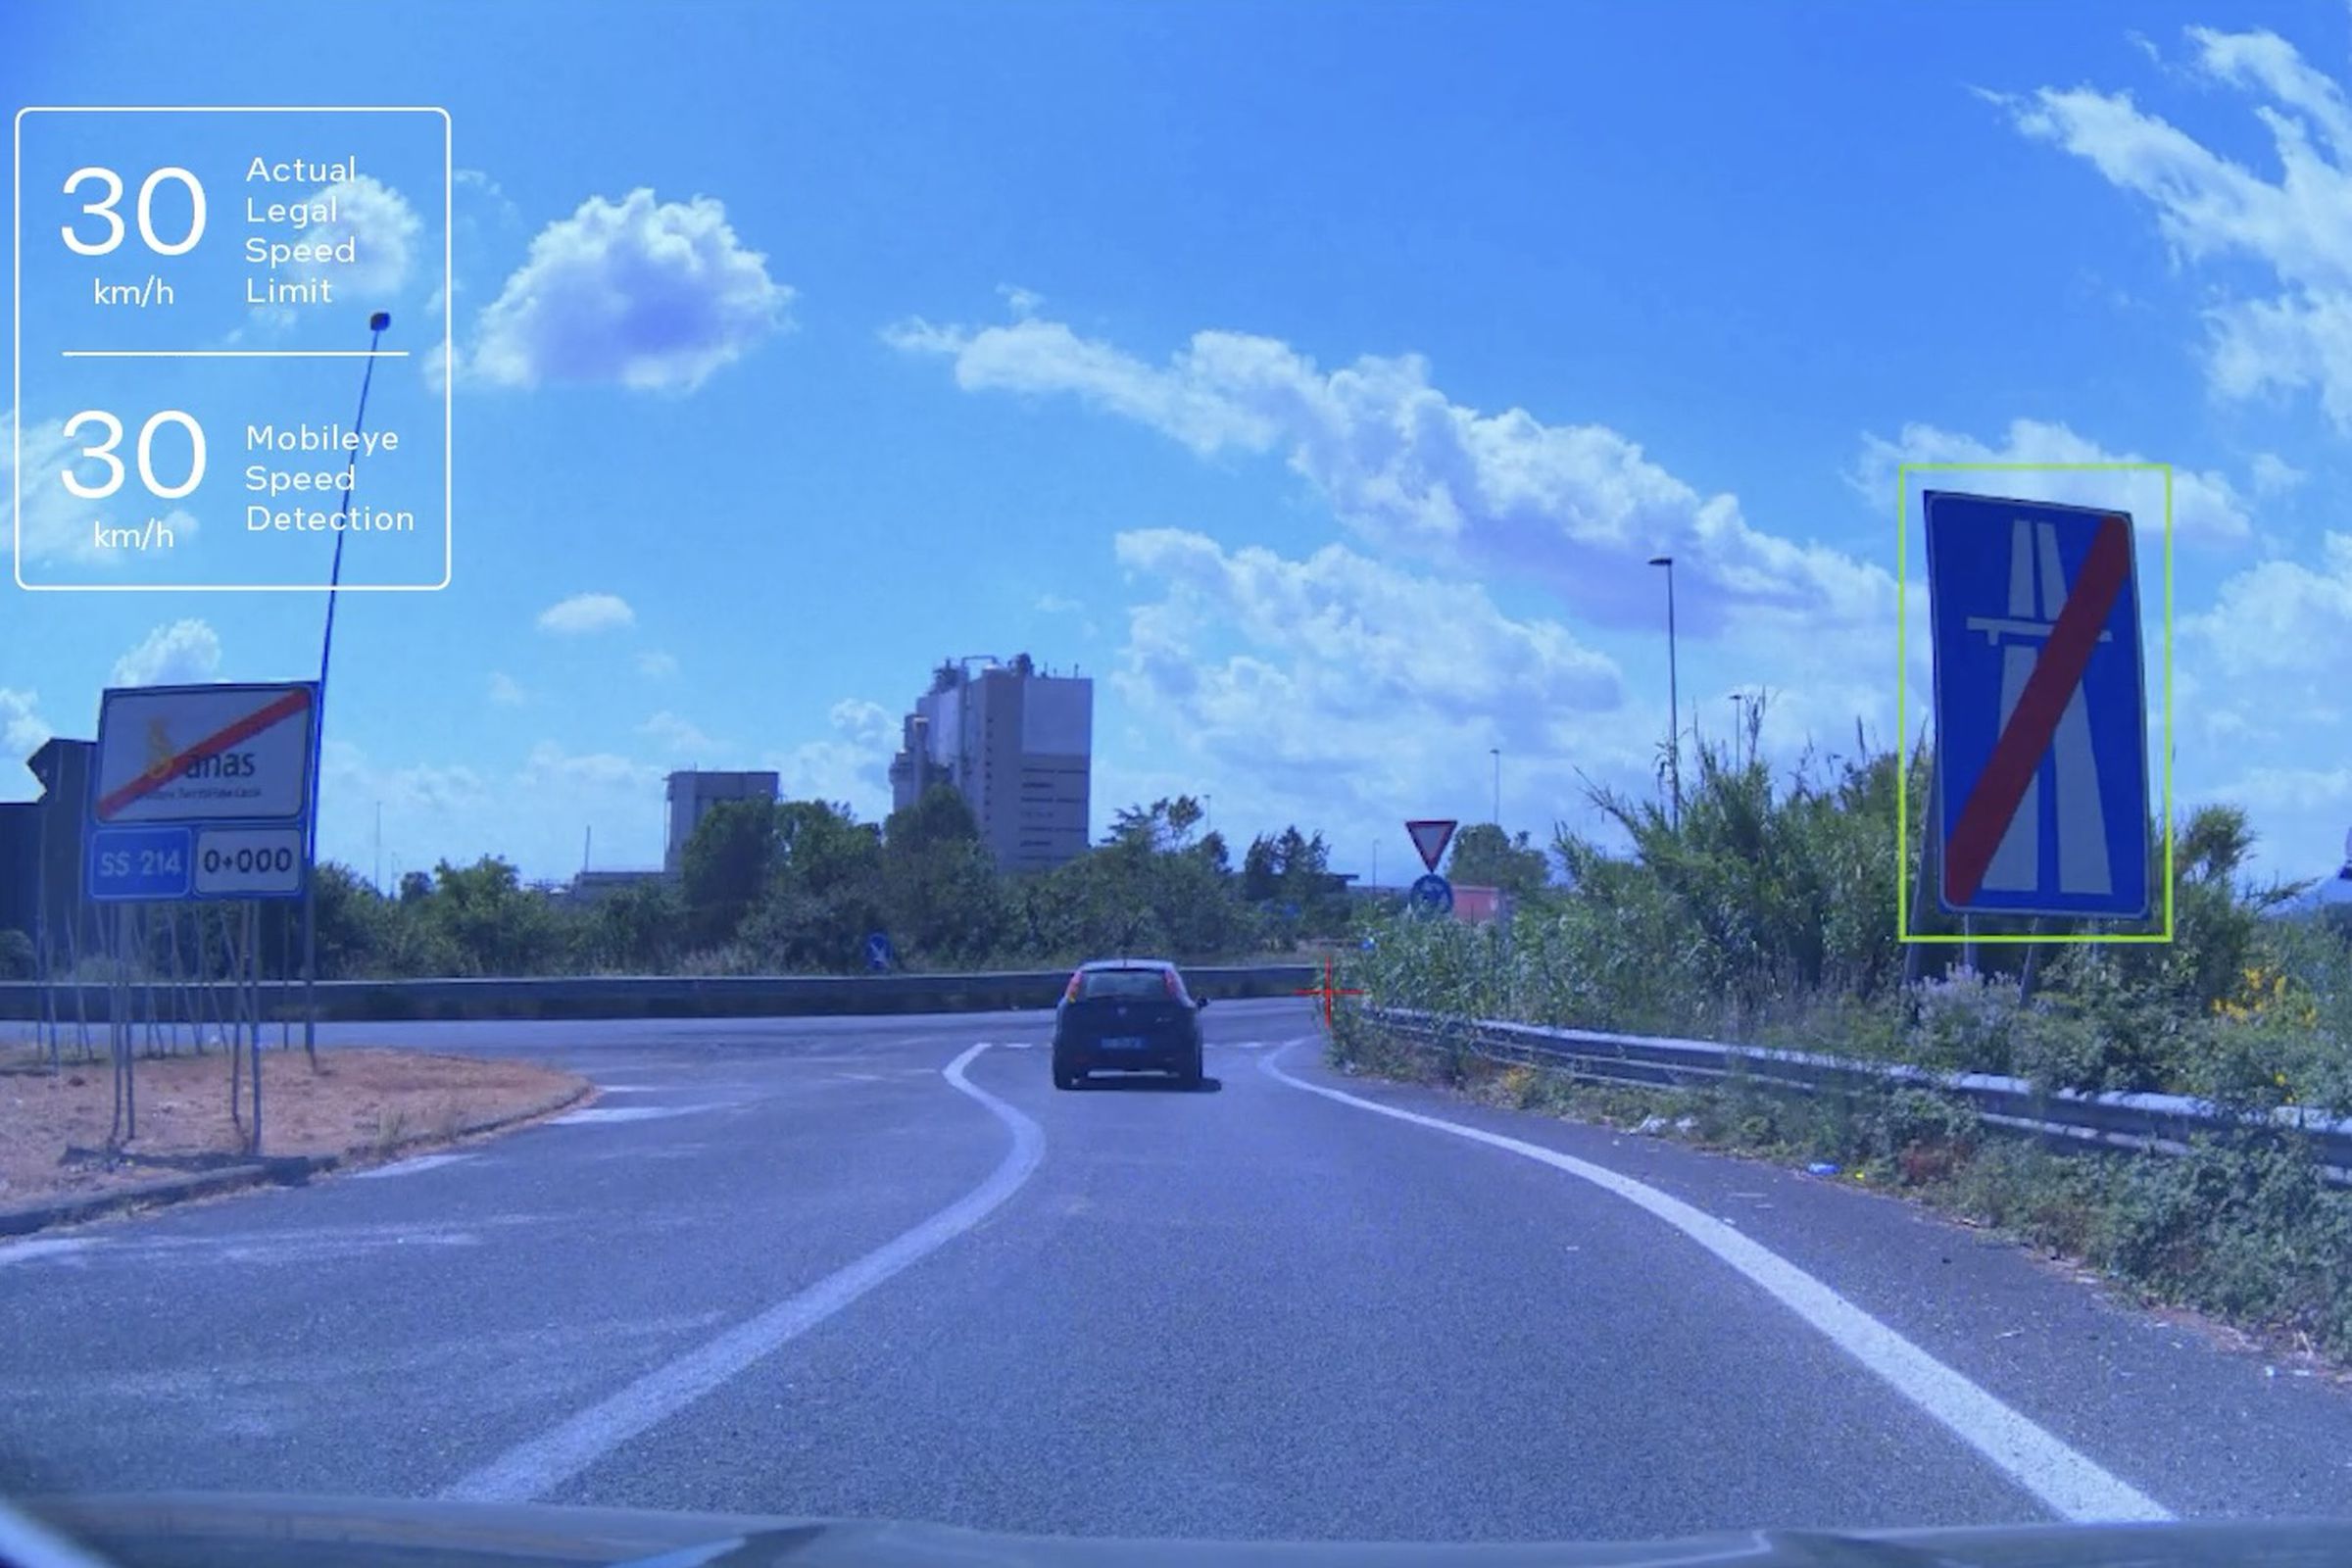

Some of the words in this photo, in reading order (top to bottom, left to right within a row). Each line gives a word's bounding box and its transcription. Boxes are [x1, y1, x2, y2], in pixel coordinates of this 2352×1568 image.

[100, 852, 130, 877] SS
[140, 849, 182, 876] 214
[204, 848, 293, 874] 0+000
